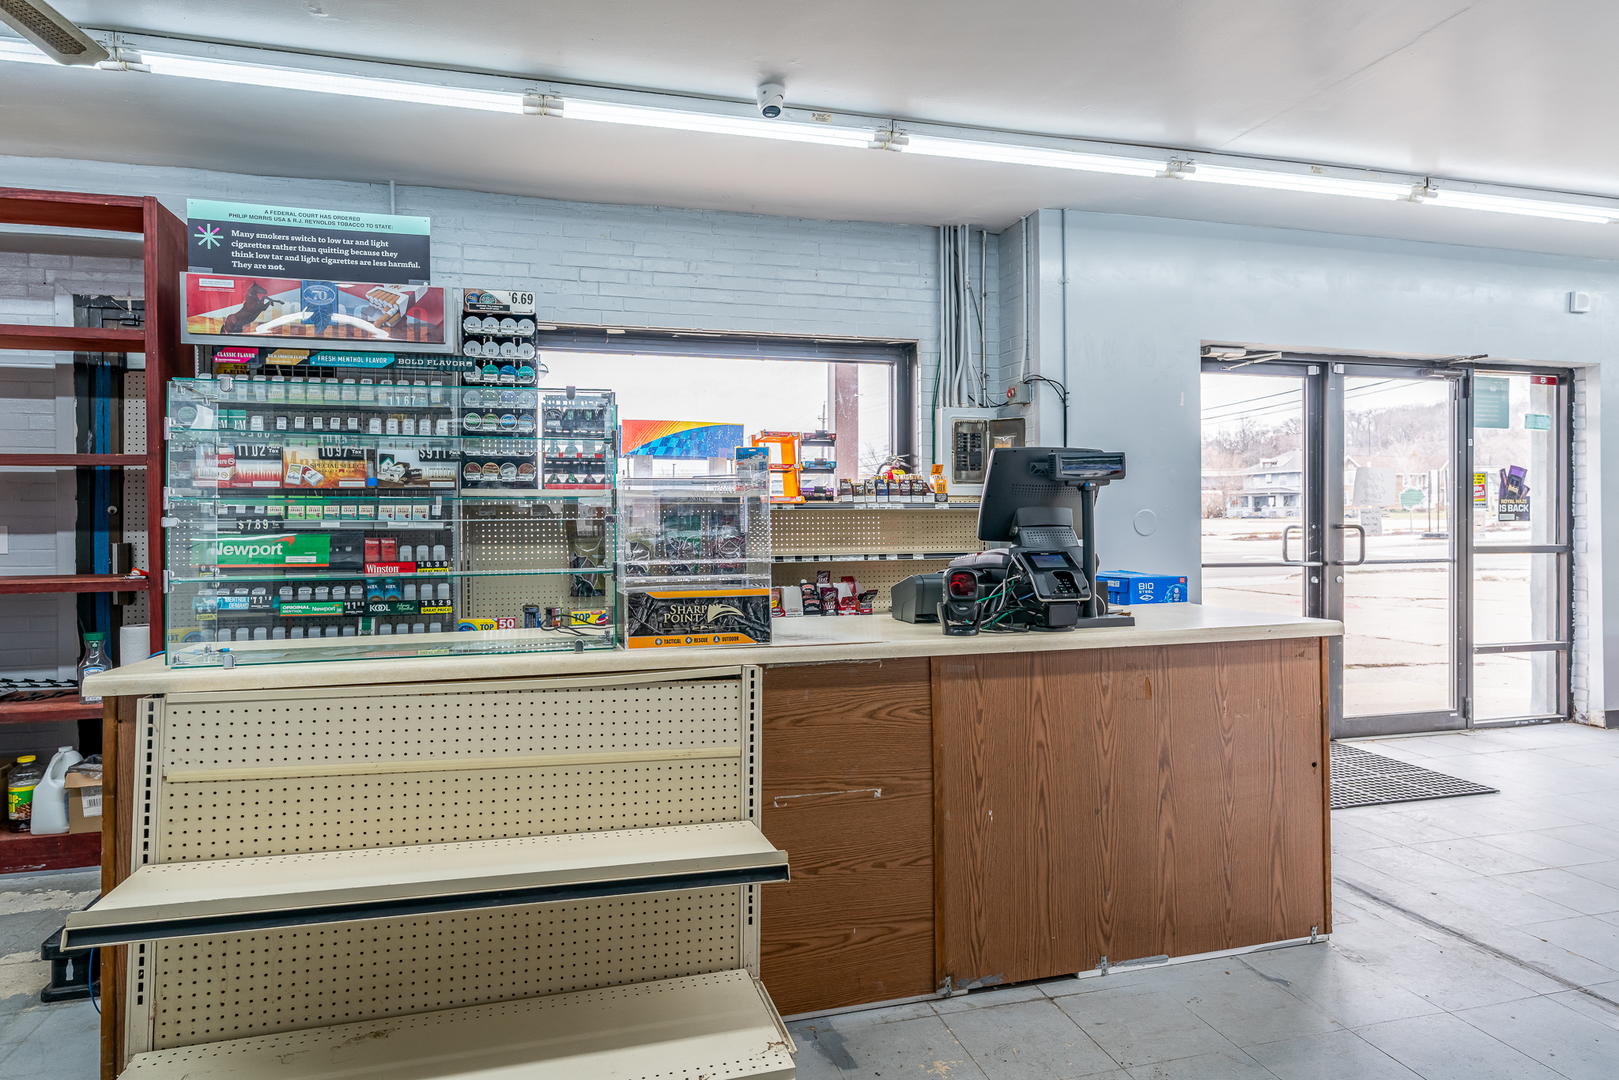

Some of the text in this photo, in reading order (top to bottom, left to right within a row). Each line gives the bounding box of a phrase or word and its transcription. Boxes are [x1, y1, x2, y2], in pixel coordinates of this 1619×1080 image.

[231, 230, 254, 239] Many
[256, 231, 289, 241] smokers
[291, 234, 316, 242] switch
[355, 238, 369, 246] and
[371, 239, 389, 248] light
[231, 240, 398, 259] cigarettes rather than quitting because they
[231, 251, 254, 259] think
[256, 252, 270, 260] low
[285, 254, 299, 262] and
[301, 255, 320, 264] light
[321, 256, 358, 265] cigarettes
[388, 260, 420, 268] harmful.
[231, 261, 252, 270] They
[311, 290, 327, 300] 70
[238, 461, 282, 479] Marlboro
[423, 462, 455, 476] Marlboro
[1500, 504, 1529, 512] IS BACK
[211, 543, 282, 558] Newport
[366, 564, 399, 573] Winston
[369, 604, 390, 612] KOOL
[670, 604, 707, 613] SHARP
[574, 613, 591, 621] TOP
[664, 614, 700, 623] POINT
[499, 619, 514, 628] 50
